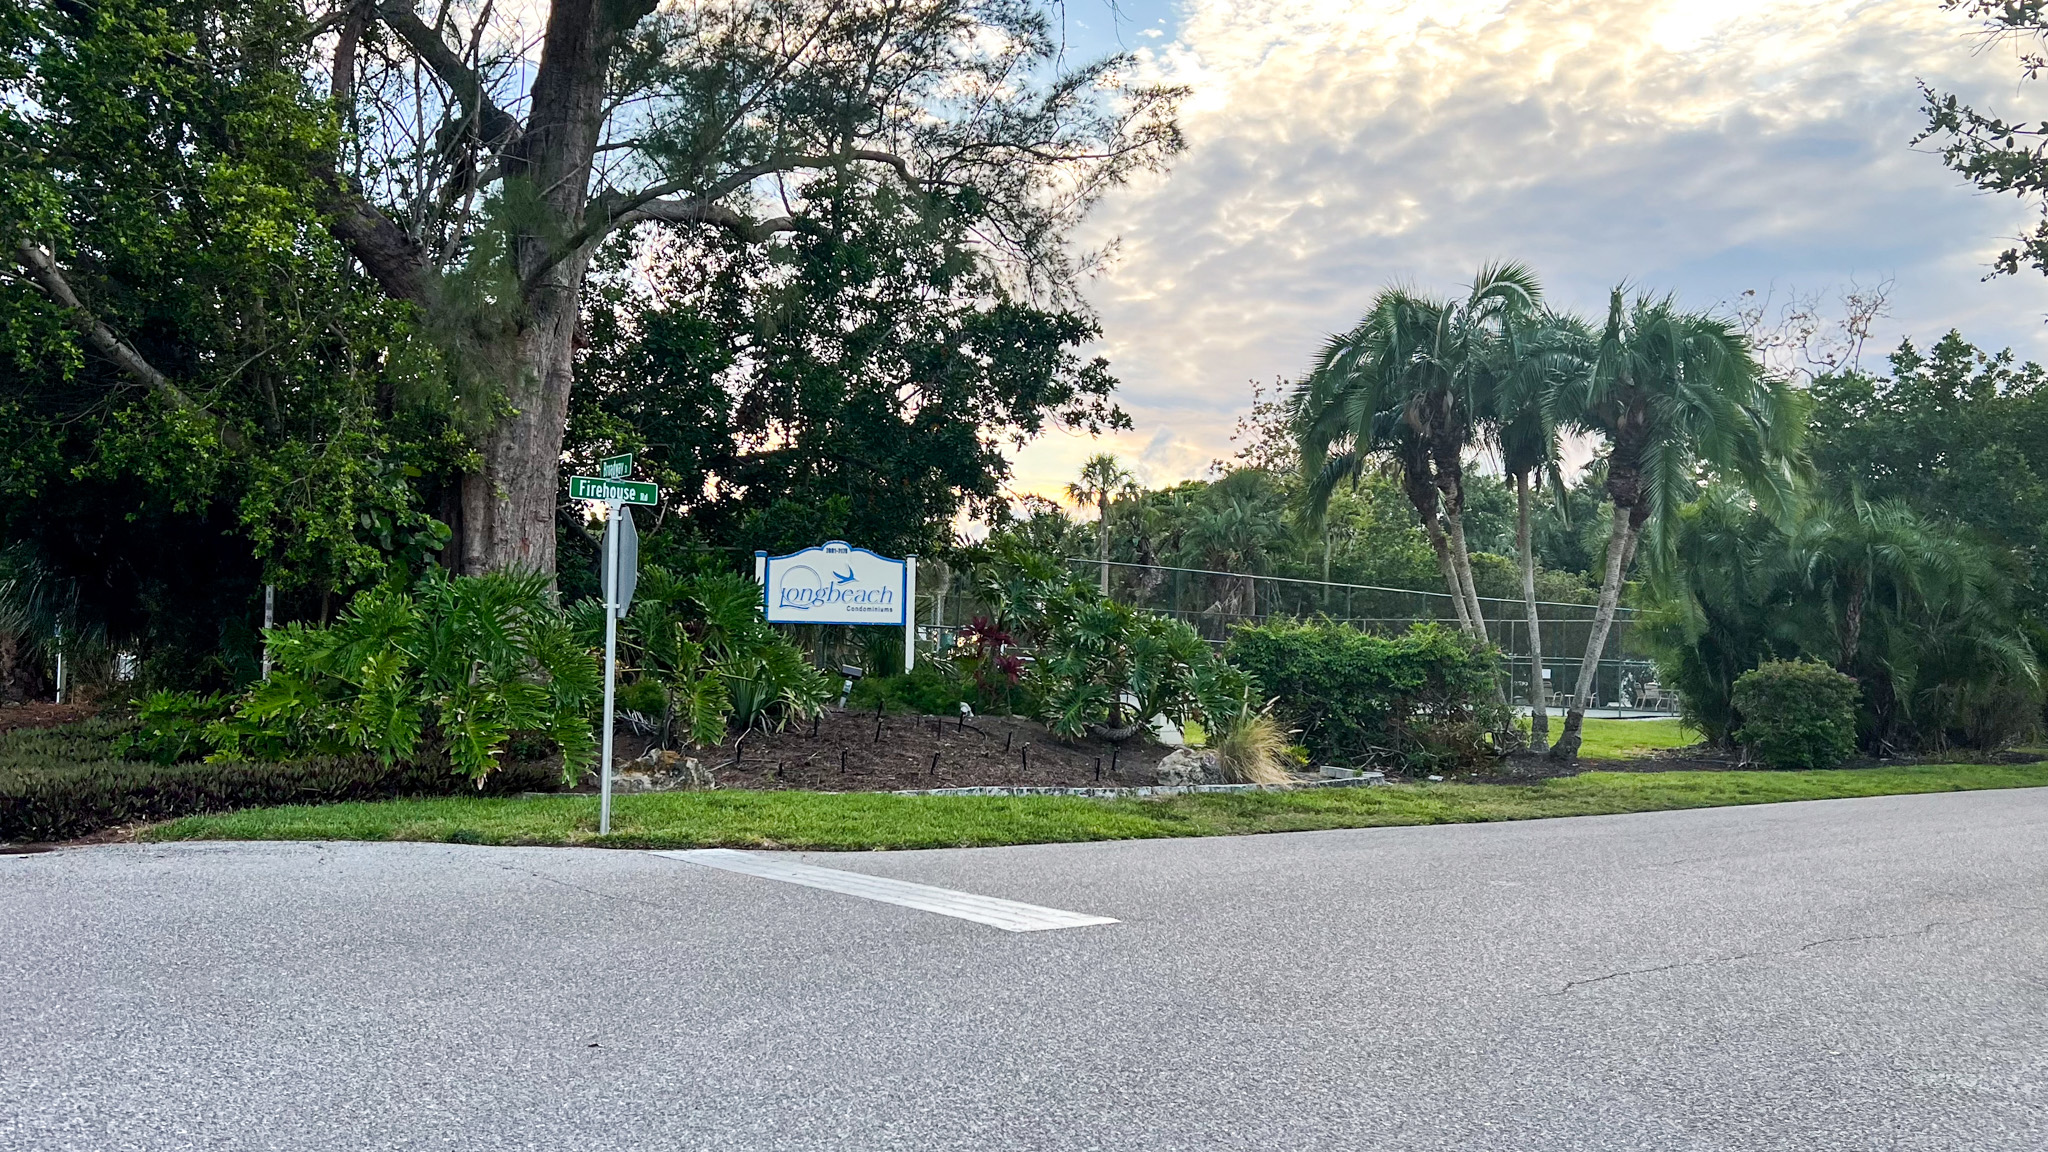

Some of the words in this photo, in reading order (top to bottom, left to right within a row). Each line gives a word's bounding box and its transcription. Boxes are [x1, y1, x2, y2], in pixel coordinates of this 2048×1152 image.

[603, 460, 624, 477] Broadway
[579, 480, 636, 500] Firehouse
[640, 493, 648, 501] Rd
[779, 581, 893, 610] Longbeach
[846, 605, 894, 613] Condominiums
